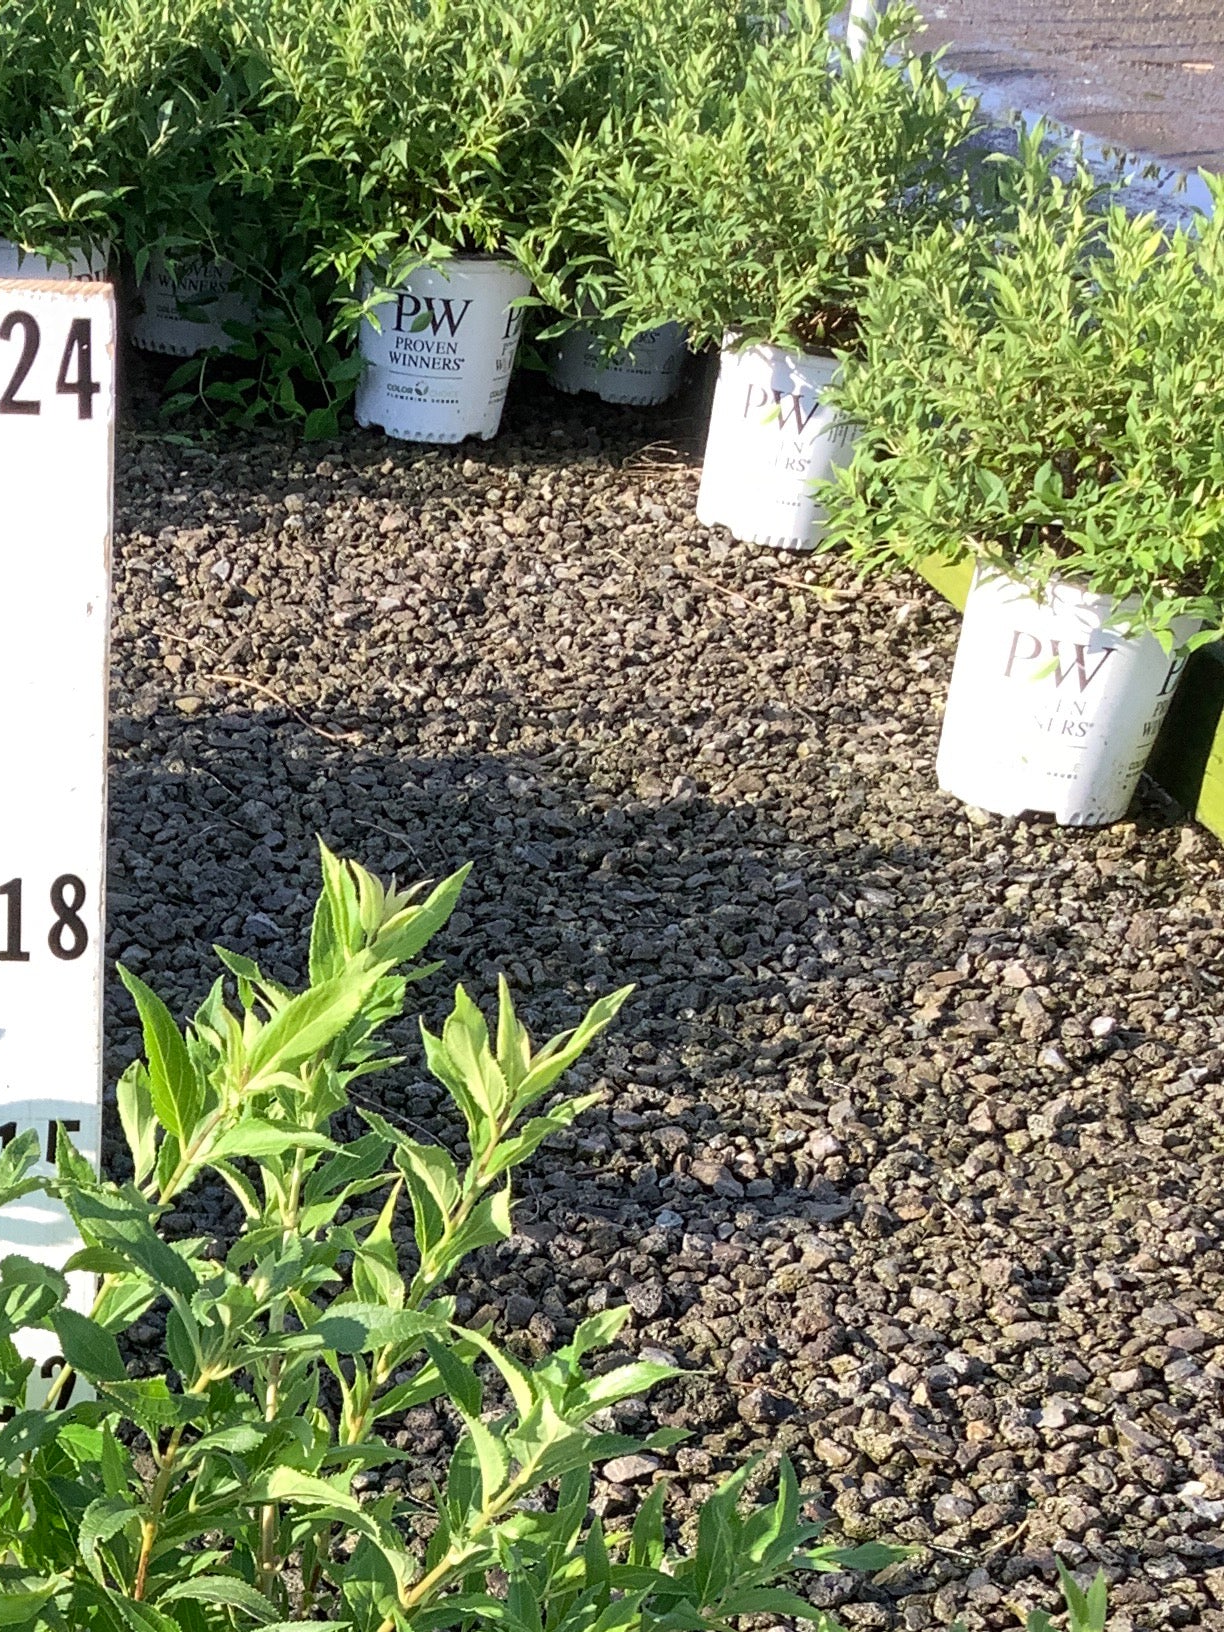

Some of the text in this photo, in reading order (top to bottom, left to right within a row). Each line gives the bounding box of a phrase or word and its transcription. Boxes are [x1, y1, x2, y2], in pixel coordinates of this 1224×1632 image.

[393, 293, 474, 338] PW
[395, 336, 458, 355] PROVEN
[1003, 629, 1118, 693] PW
